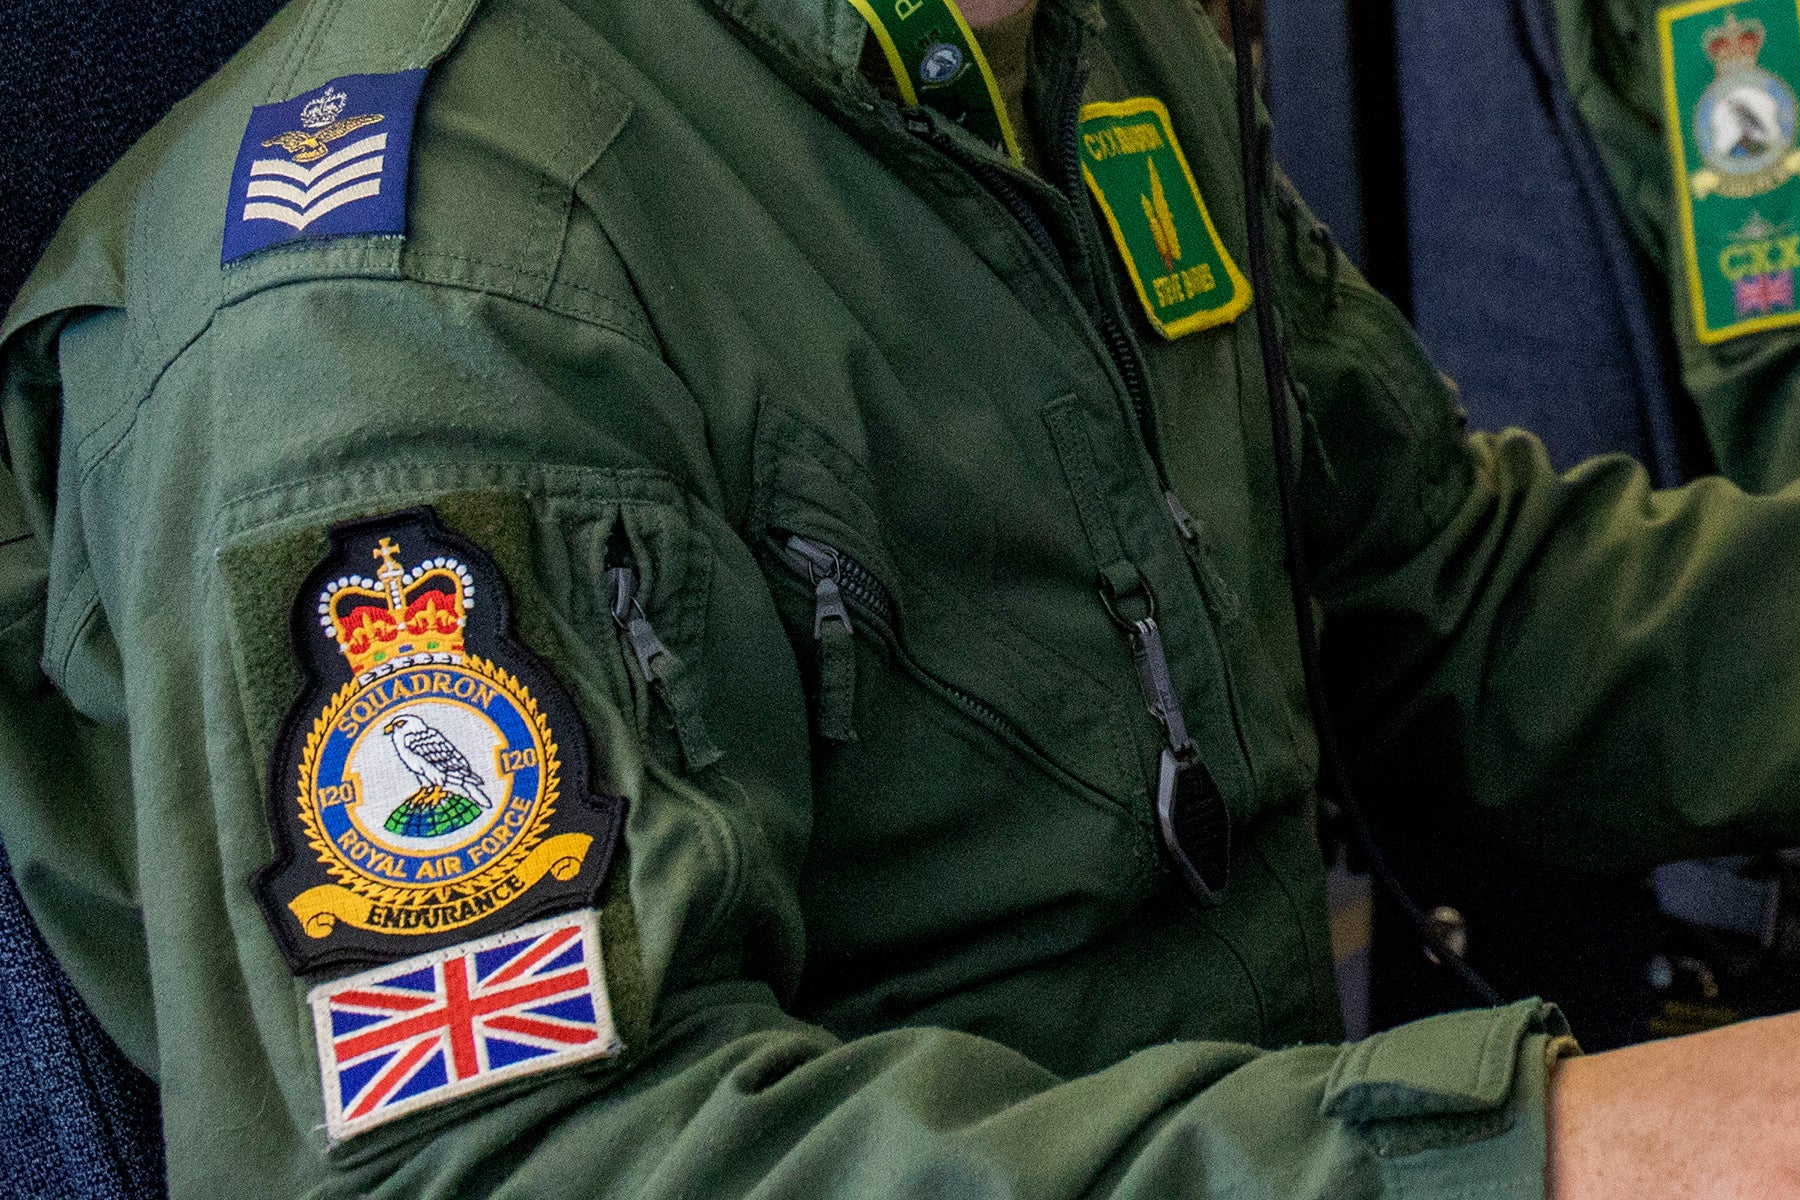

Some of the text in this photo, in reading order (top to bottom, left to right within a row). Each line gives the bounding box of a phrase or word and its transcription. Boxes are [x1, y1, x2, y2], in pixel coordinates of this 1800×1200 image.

[337, 675, 497, 739] SQUADRON
[501, 748, 538, 773] 120
[317, 781, 355, 809] 120
[337, 796, 531, 880] ROYAL AIR FORCE
[364, 874, 526, 929] ENDURANCE
